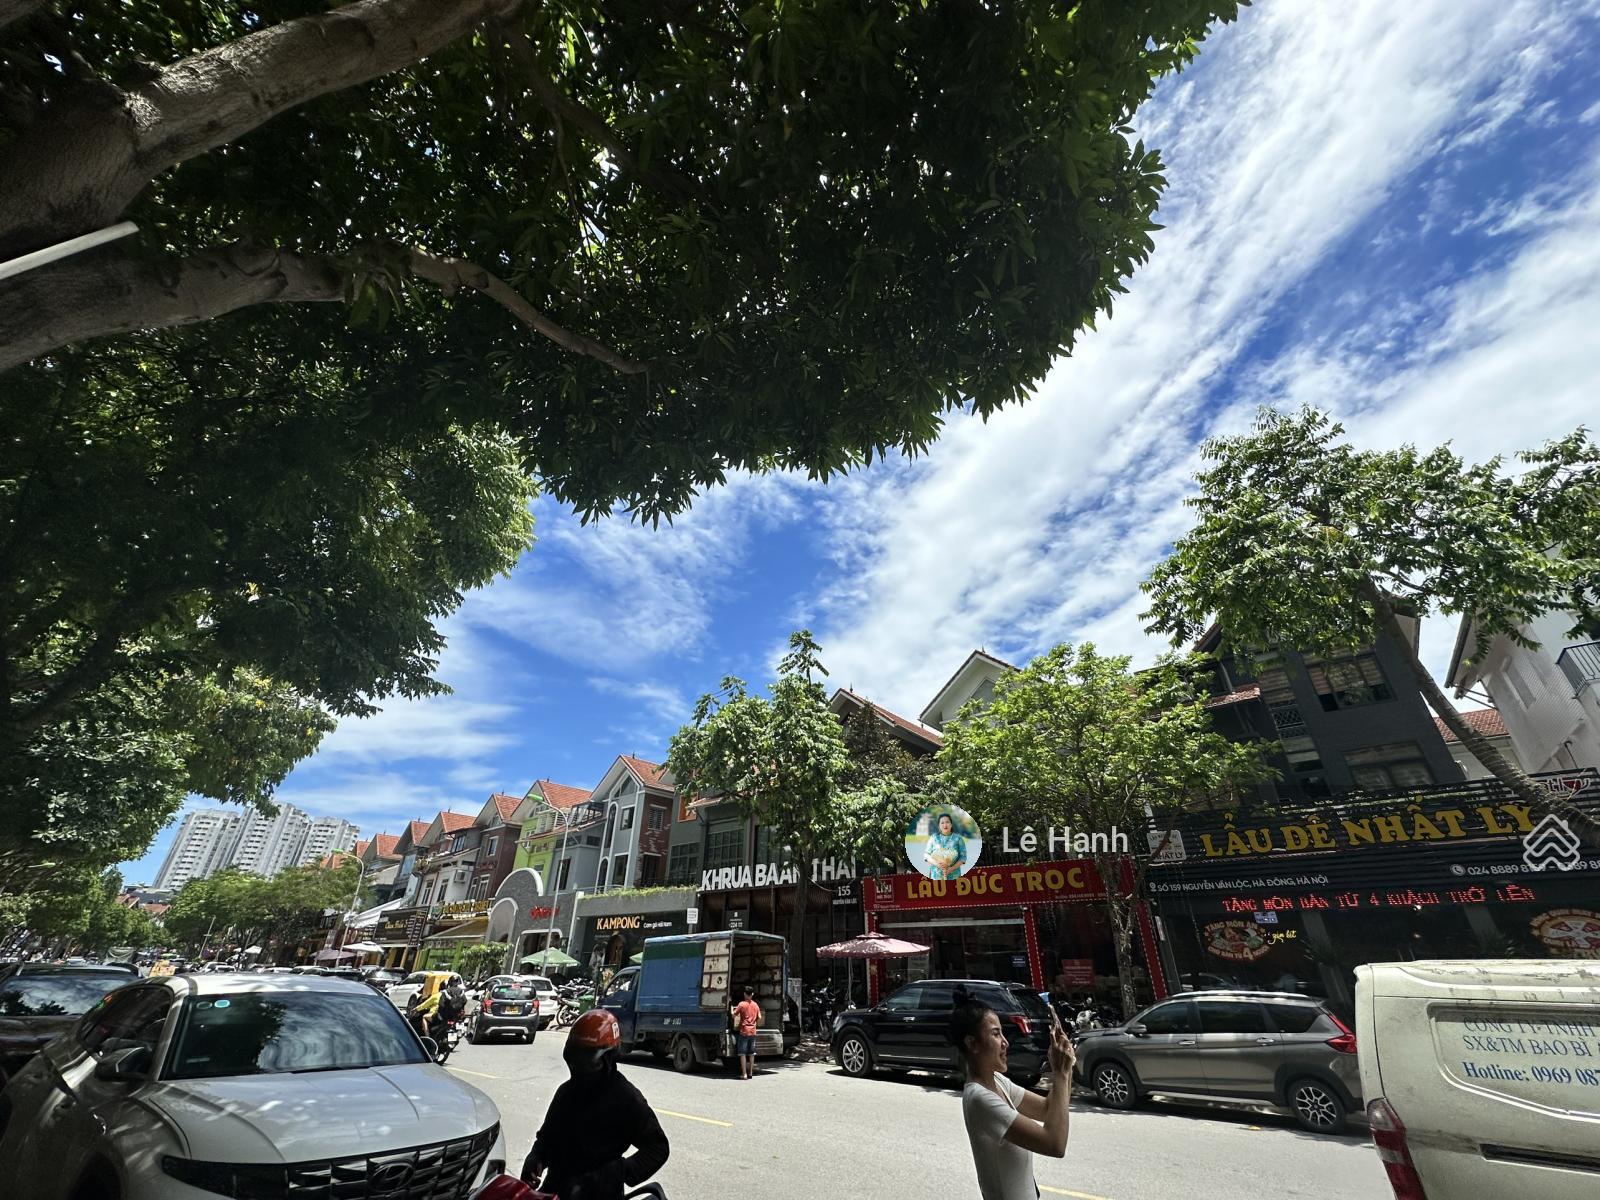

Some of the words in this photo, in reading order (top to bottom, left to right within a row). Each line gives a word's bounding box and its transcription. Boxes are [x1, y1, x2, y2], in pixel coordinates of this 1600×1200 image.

[1200, 813, 1273, 857] LẨU
[1280, 815, 1336, 850] DÊ
[1341, 795, 1467, 845] NHẤT
[1475, 804, 1536, 835] LY
[700, 865, 753, 892] KHRUA
[811, 855, 857, 882] THAI
[1467, 866, 1490, 875] 024
[1490, 864, 1519, 874] 8889
[837, 885, 851, 897] 155
[956, 868, 1004, 896] ĐỨC
[1011, 867, 1085, 893] TRỌC
[596, 915, 641, 930] KAMPONG
[1462, 1035, 1527, 1054] SX&TM
[1528, 1039, 1568, 1056] BAO
[1569, 1037, 1593, 1057] BÌ
[1462, 1061, 1530, 1082] Hotline:
[1531, 1065, 1572, 1084] 0969
